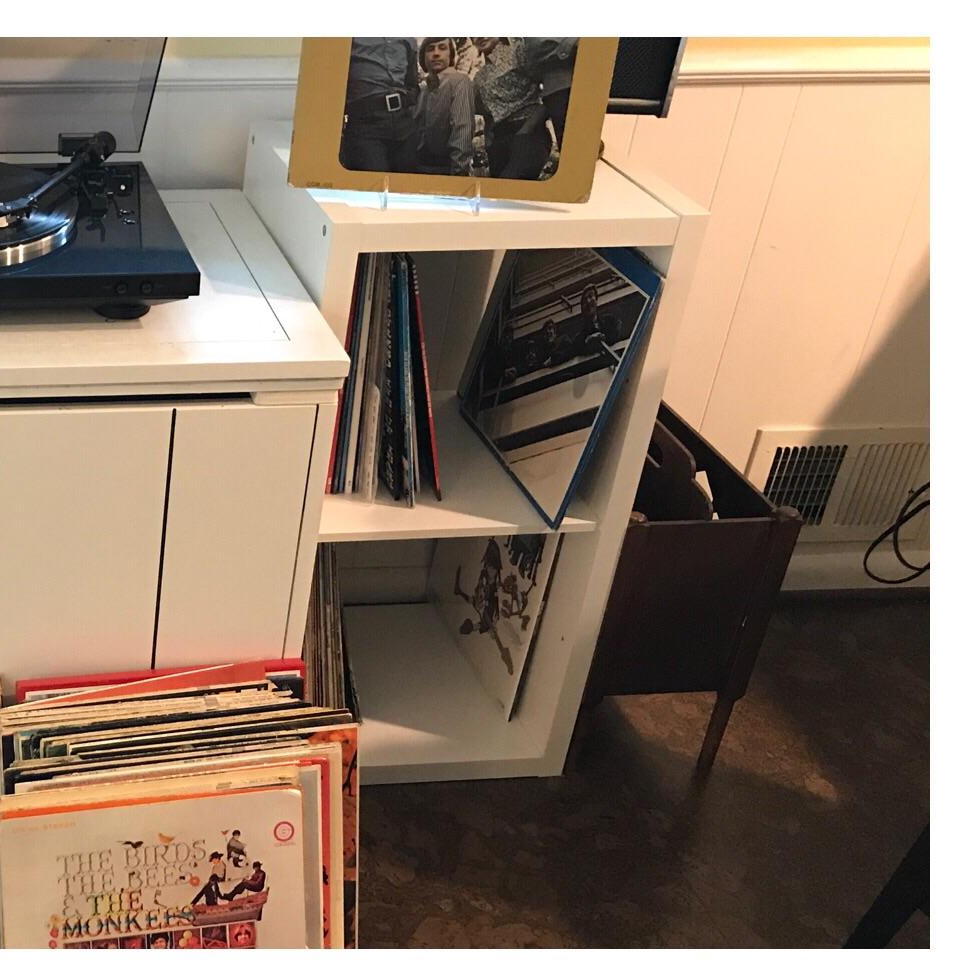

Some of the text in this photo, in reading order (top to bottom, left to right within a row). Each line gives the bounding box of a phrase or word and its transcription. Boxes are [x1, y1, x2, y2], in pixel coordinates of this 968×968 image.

[56, 849, 112, 876] THE
[58, 867, 115, 897] THE
[86, 888, 144, 916] THE
[62, 905, 196, 939] MONKEES
